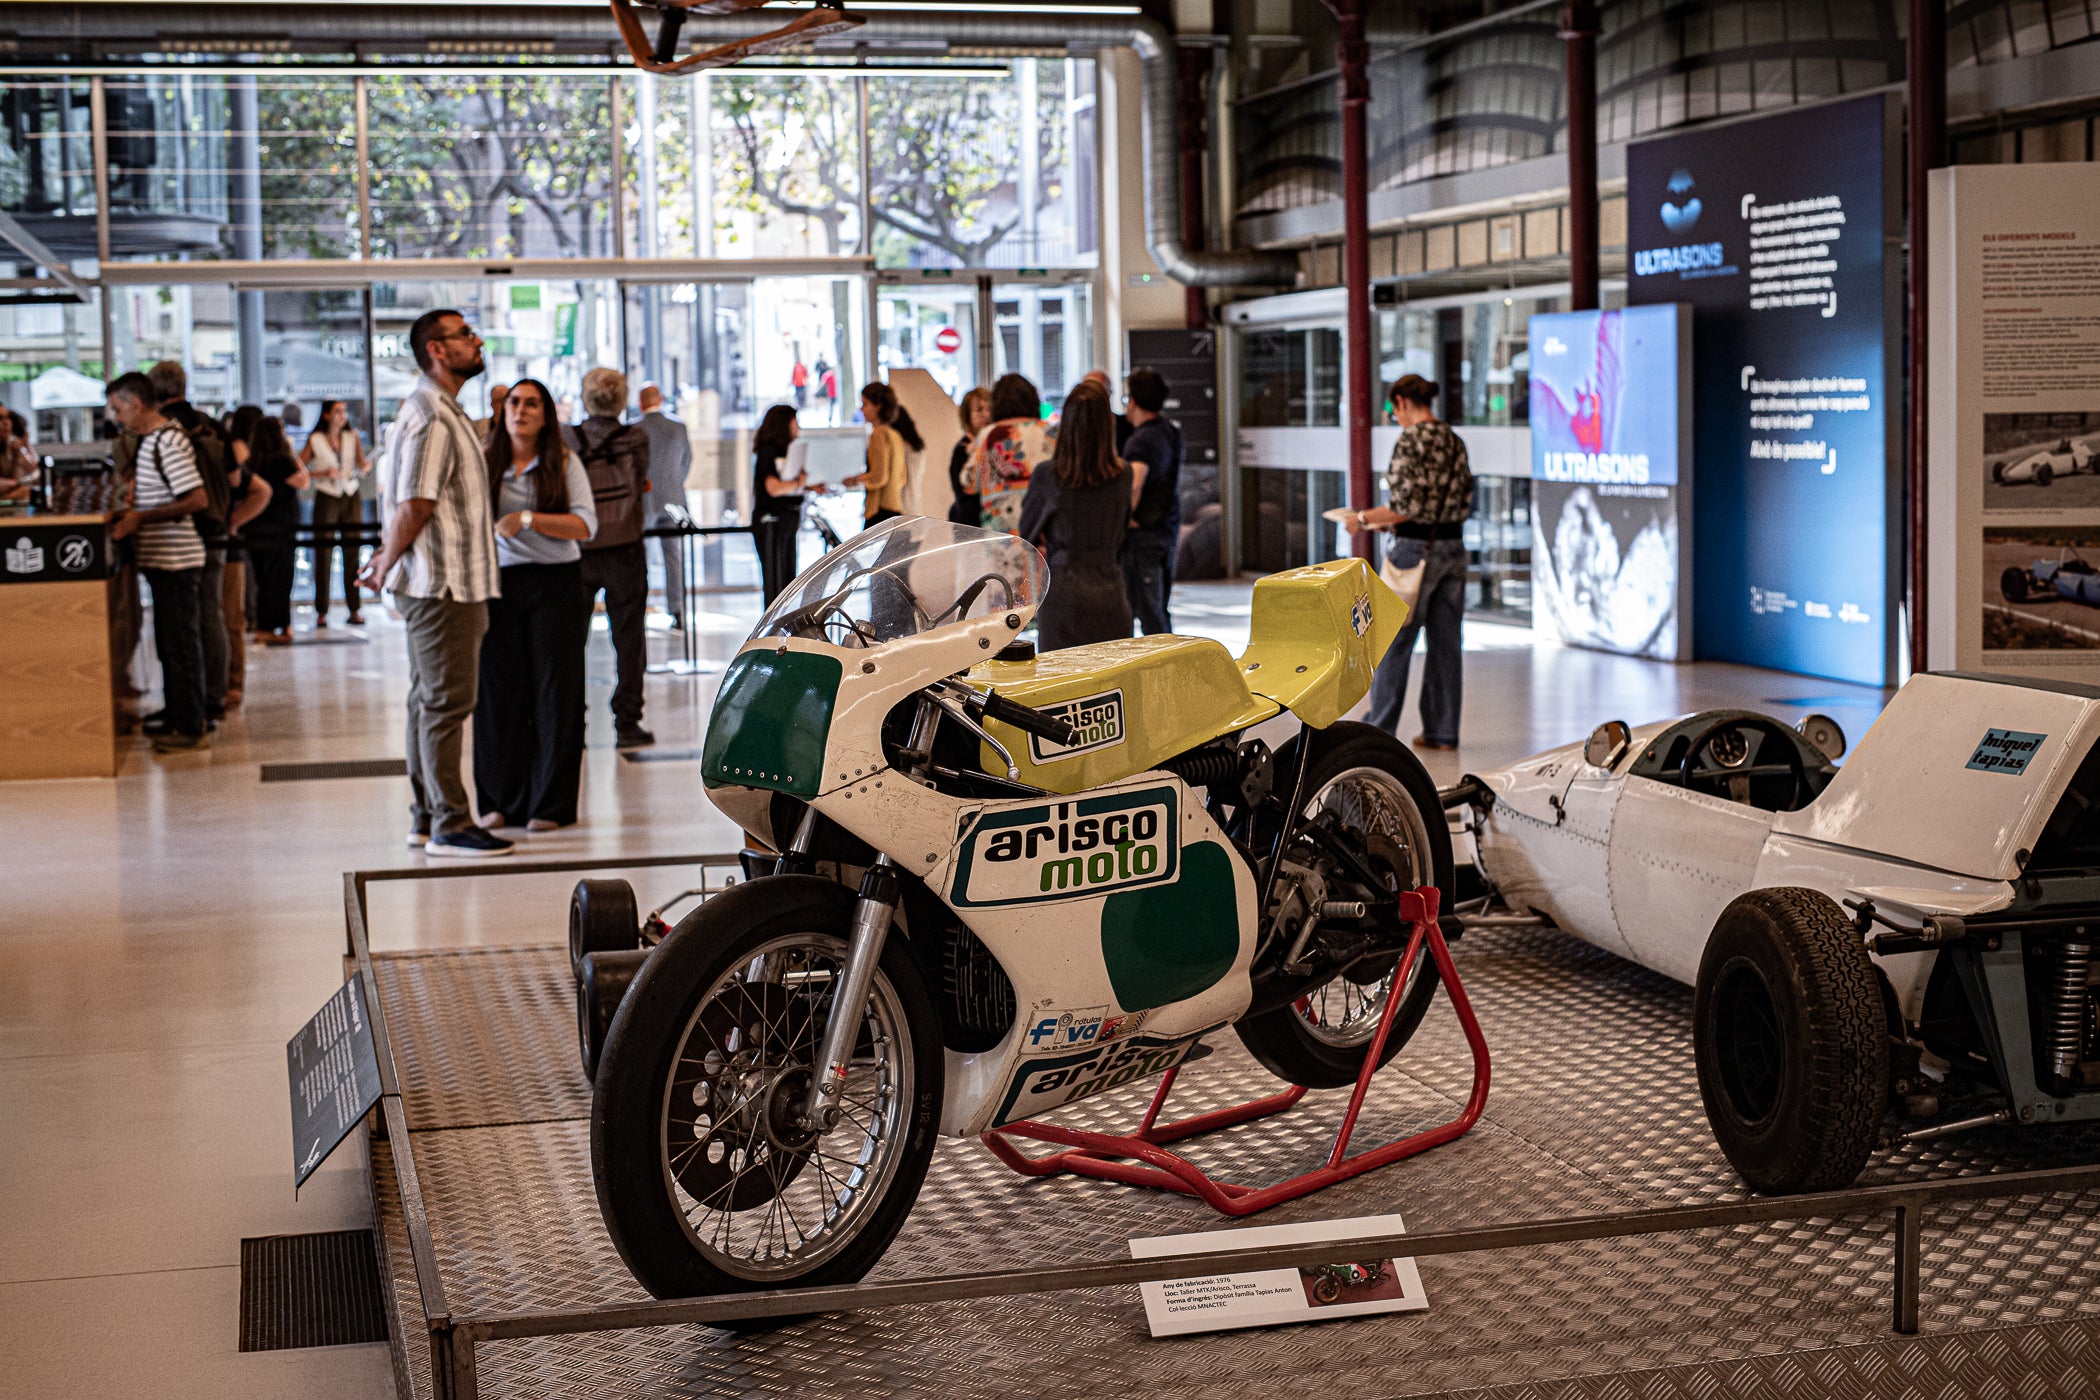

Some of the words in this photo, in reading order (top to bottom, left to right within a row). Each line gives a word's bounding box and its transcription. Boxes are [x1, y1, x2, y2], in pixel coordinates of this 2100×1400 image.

[1544, 451, 1650, 485] ULTRASONS
[1058, 703, 1115, 729] risco
[1972, 750, 2025, 768] tapias
[985, 803, 1157, 862] arisco
[1040, 826, 1157, 892] moto
[1184, 1279, 1215, 1287] fabricació:
[1255, 1288, 1274, 1297] Tapias
[1197, 1301, 1227, 1310] MNACTEC
